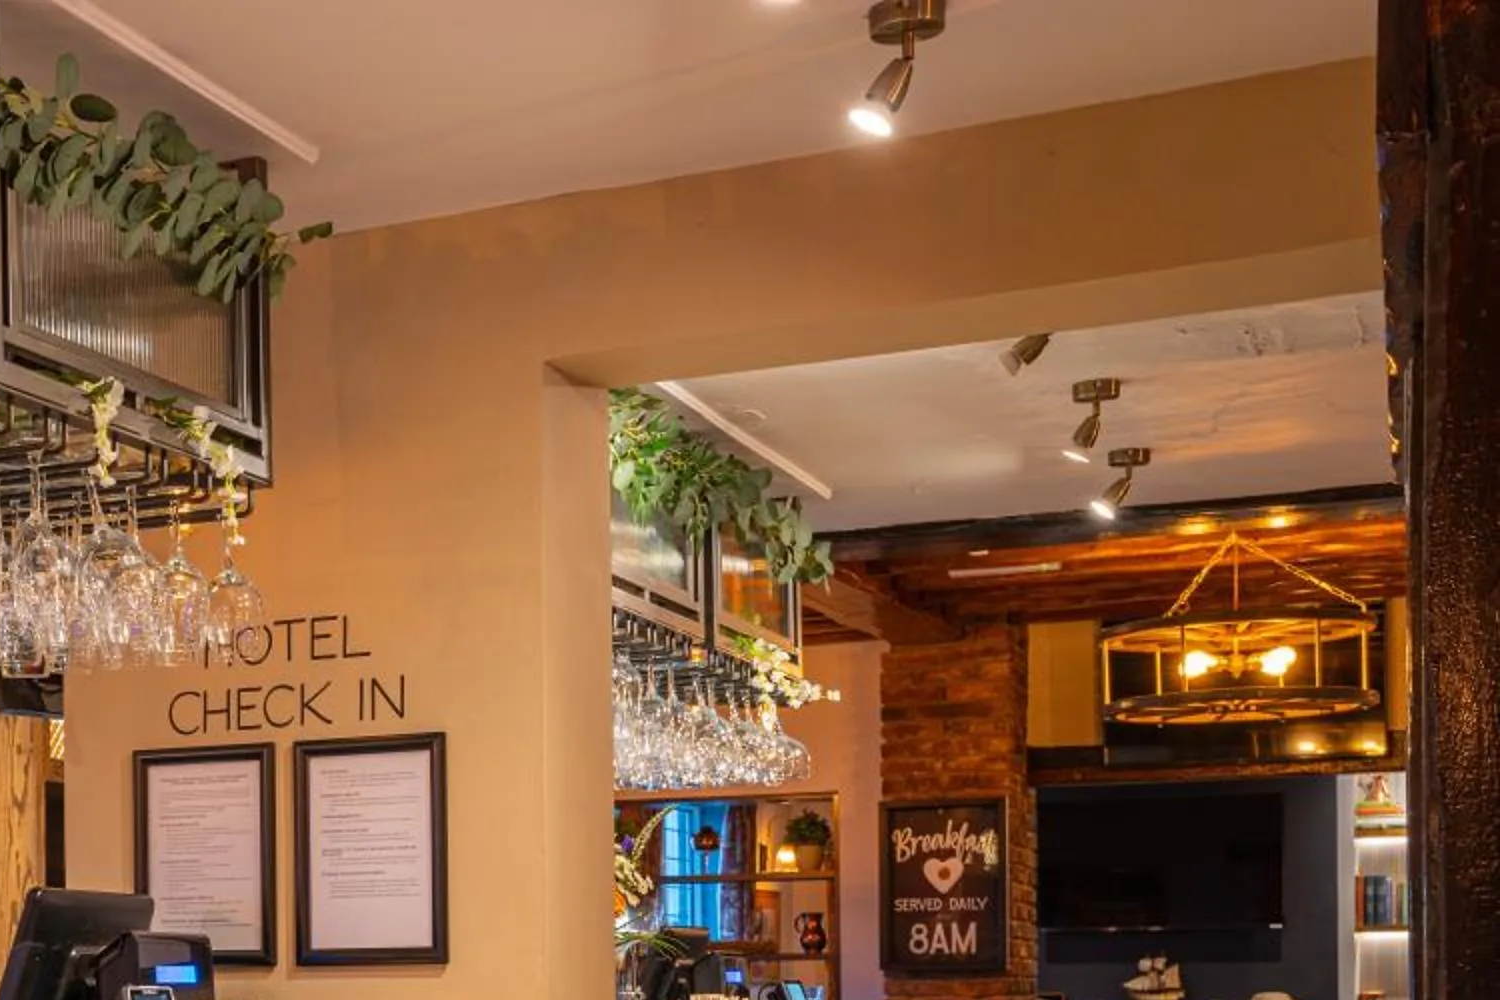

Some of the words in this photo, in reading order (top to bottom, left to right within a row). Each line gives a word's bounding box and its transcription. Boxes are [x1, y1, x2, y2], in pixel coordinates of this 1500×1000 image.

[203, 615, 371, 670] HOTEL
[168, 681, 333, 735] CHECK
[358, 674, 405, 721] IN
[893, 897, 943, 911] SERVED
[949, 896, 988, 911] DAILY
[908, 921, 977, 955] 8AM
